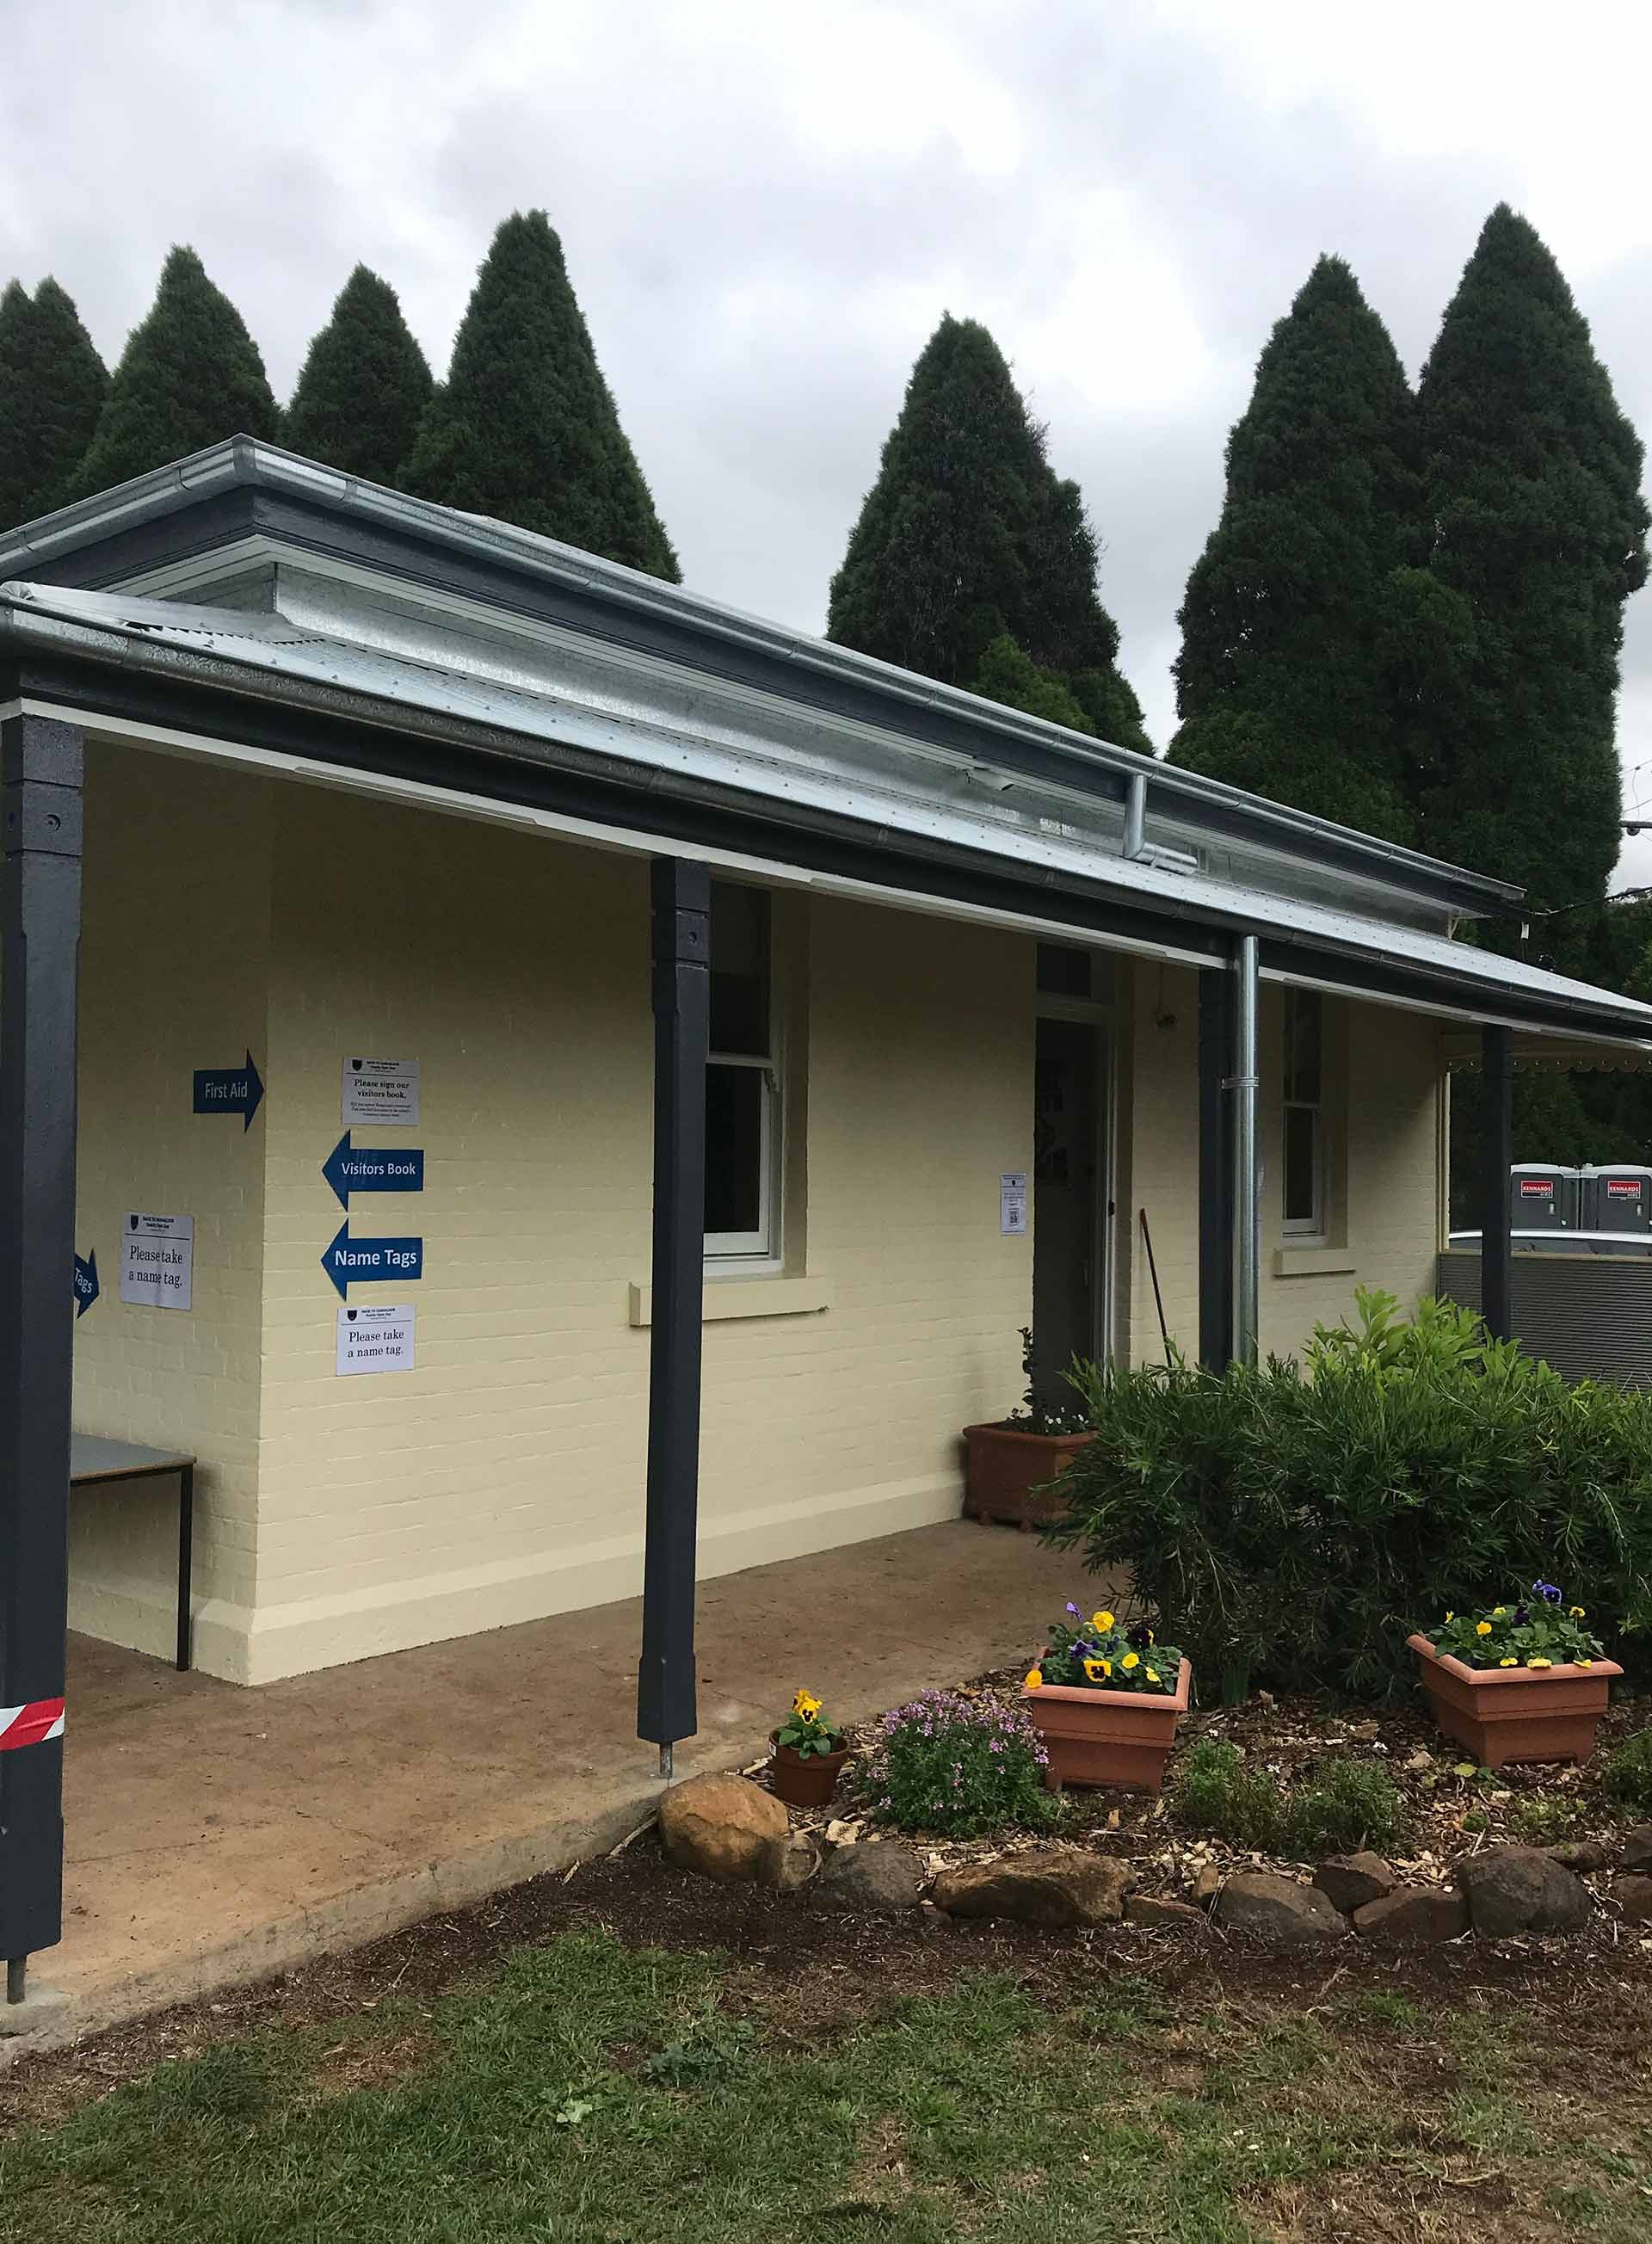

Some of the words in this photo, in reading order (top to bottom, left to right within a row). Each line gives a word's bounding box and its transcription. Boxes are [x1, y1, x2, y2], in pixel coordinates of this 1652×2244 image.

[205, 1082, 228, 1099] First
[229, 1080, 248, 1099] Aid
[354, 1078, 379, 1088] Please
[379, 1080, 395, 1089] sign
[357, 1089, 385, 1098] visitors
[386, 1090, 407, 1100] book.
[341, 1162, 385, 1175] Visitors
[387, 1162, 416, 1175] Book
[129, 1245, 160, 1262] Please
[161, 1248, 183, 1264] take
[335, 1249, 380, 1267] Name
[384, 1248, 417, 1269] Tags
[74, 1266, 93, 1294] Tags
[128, 1270, 134, 1281] a
[136, 1271, 162, 1285] name
[163, 1272, 183, 1289] tag.
[348, 1331, 381, 1343] Please
[383, 1329, 404, 1341] take
[347, 1349, 354, 1359] a
[356, 1347, 384, 1358] name
[385, 1345, 404, 1357] tag.
